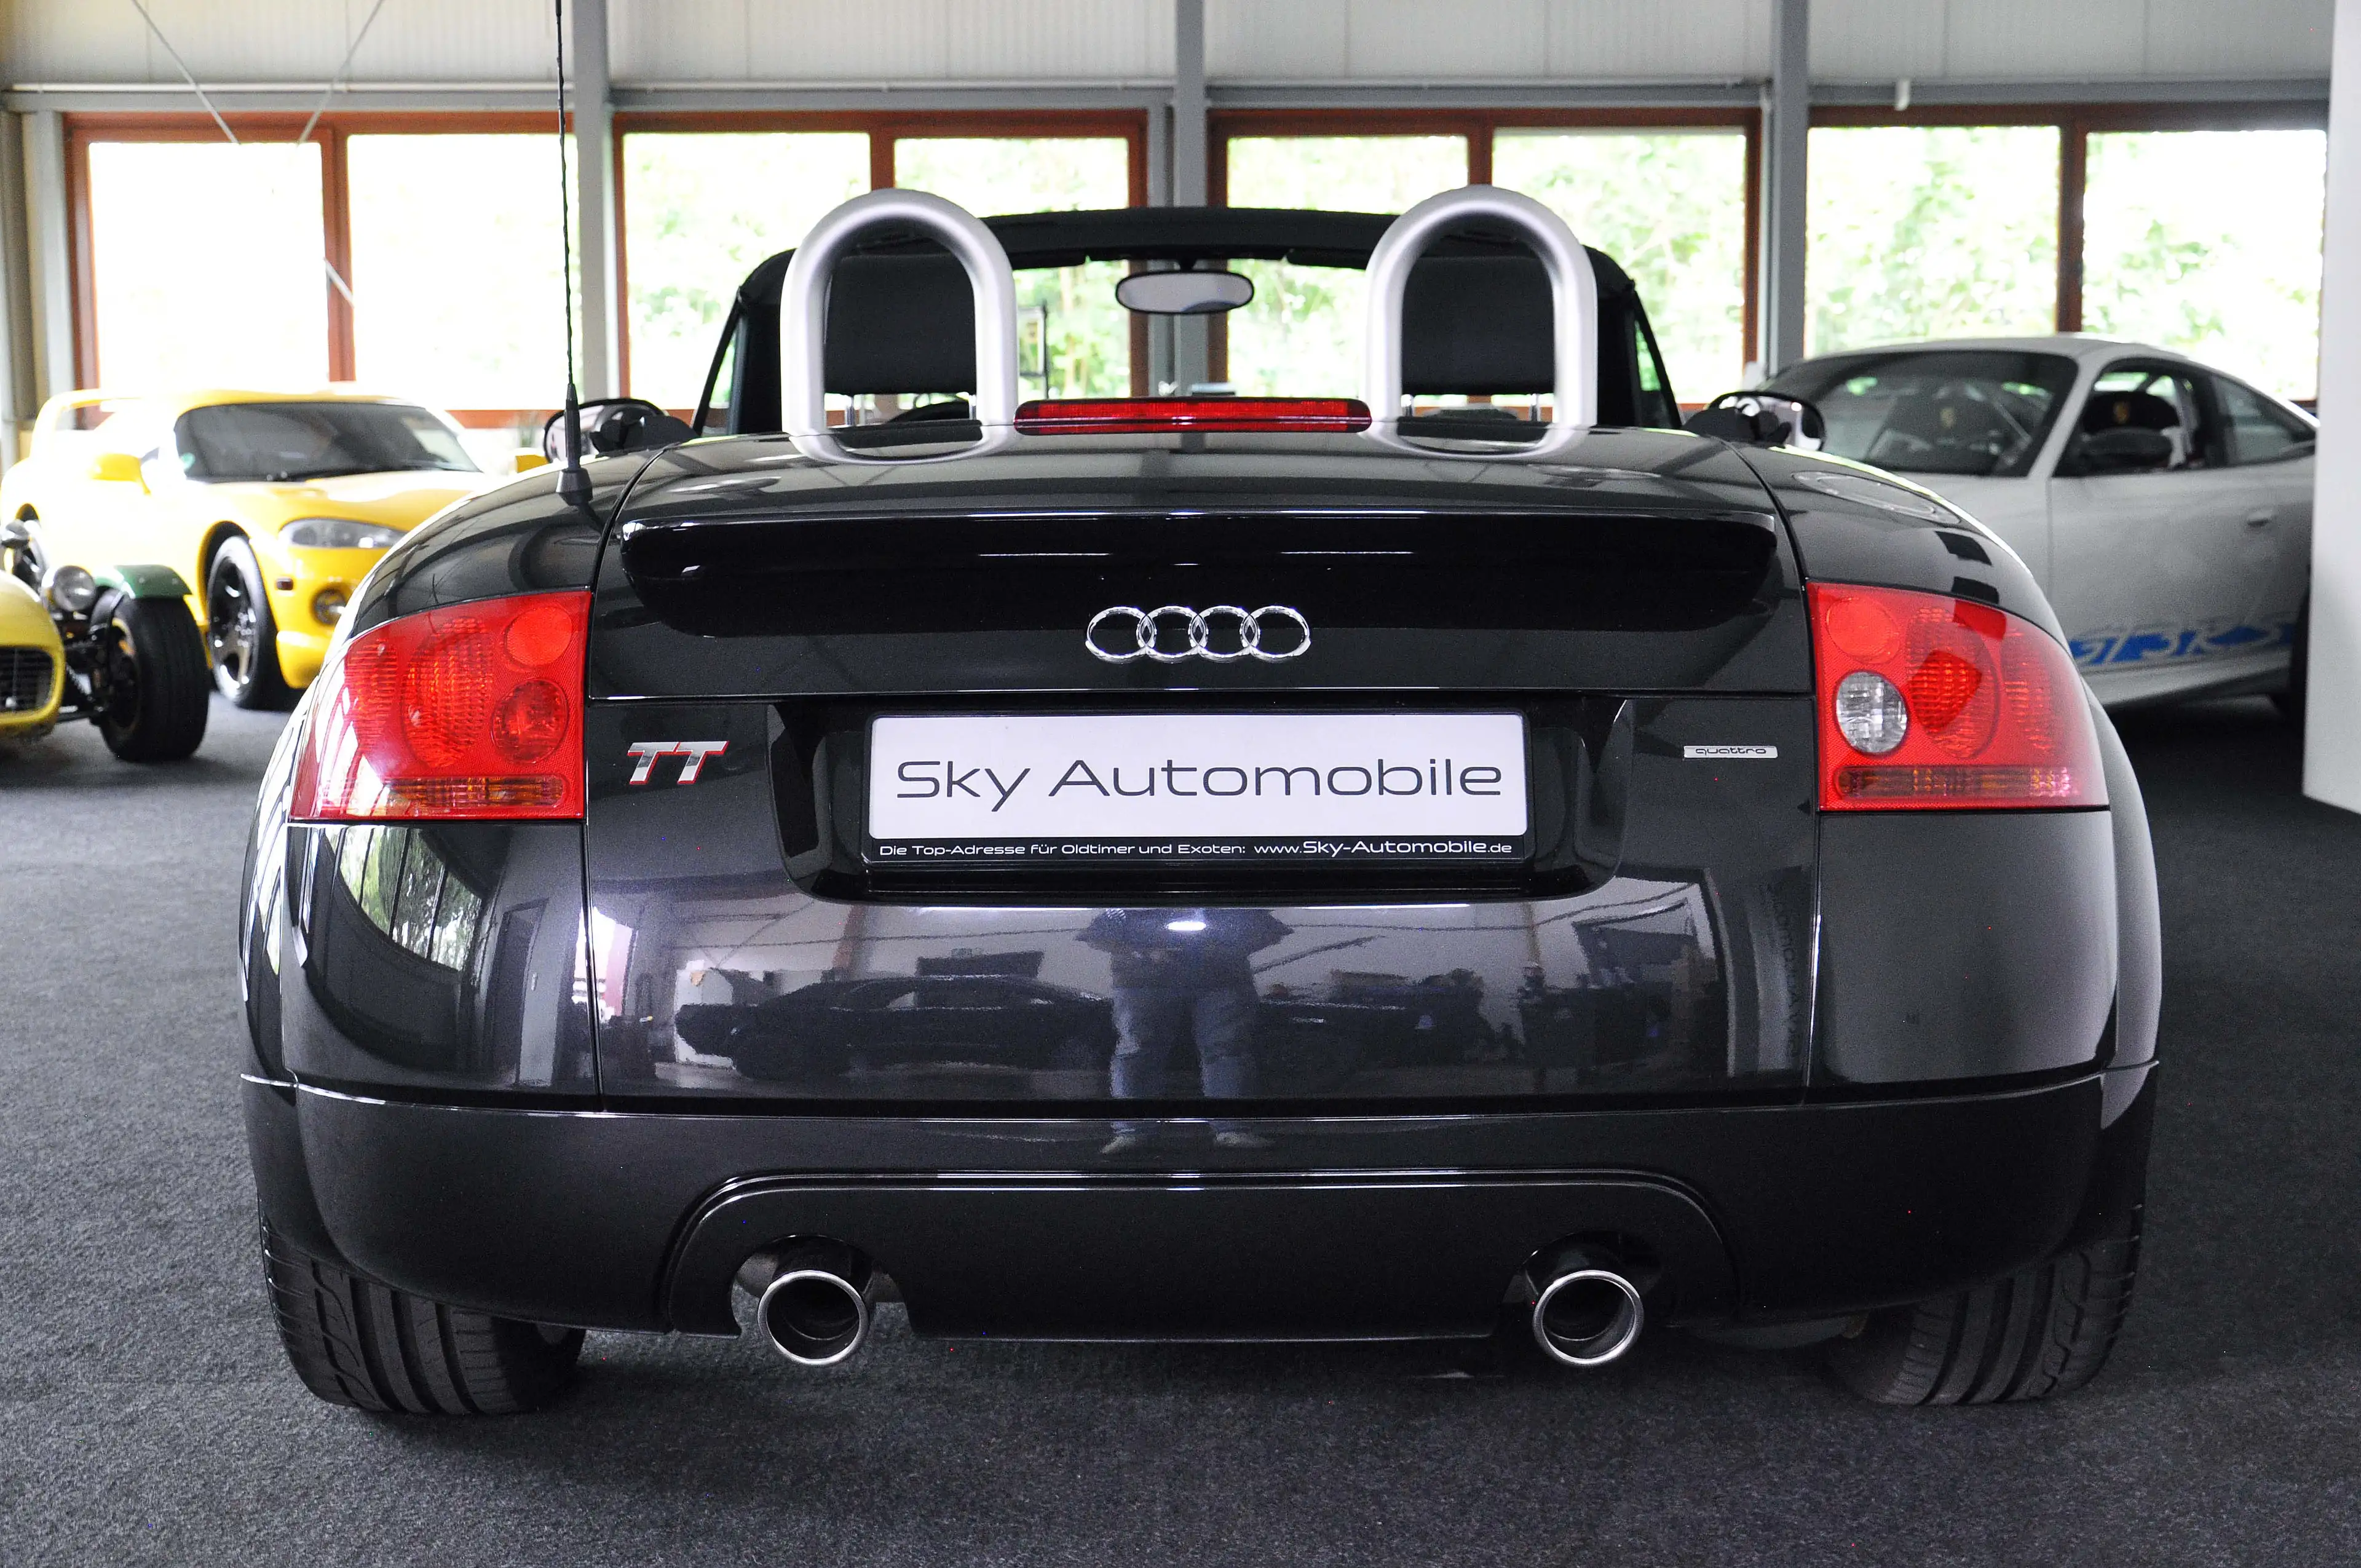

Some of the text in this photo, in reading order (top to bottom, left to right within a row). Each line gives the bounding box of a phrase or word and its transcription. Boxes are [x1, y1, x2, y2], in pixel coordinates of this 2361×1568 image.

[627, 740, 730, 785] TT
[1695, 747, 1766, 756] quattro
[897, 759, 1501, 812] Sky Automobile
[879, 840, 1512, 858] Die Top-Adresse für Oldtimer und Exoten: www.Sky-Automobile.de
